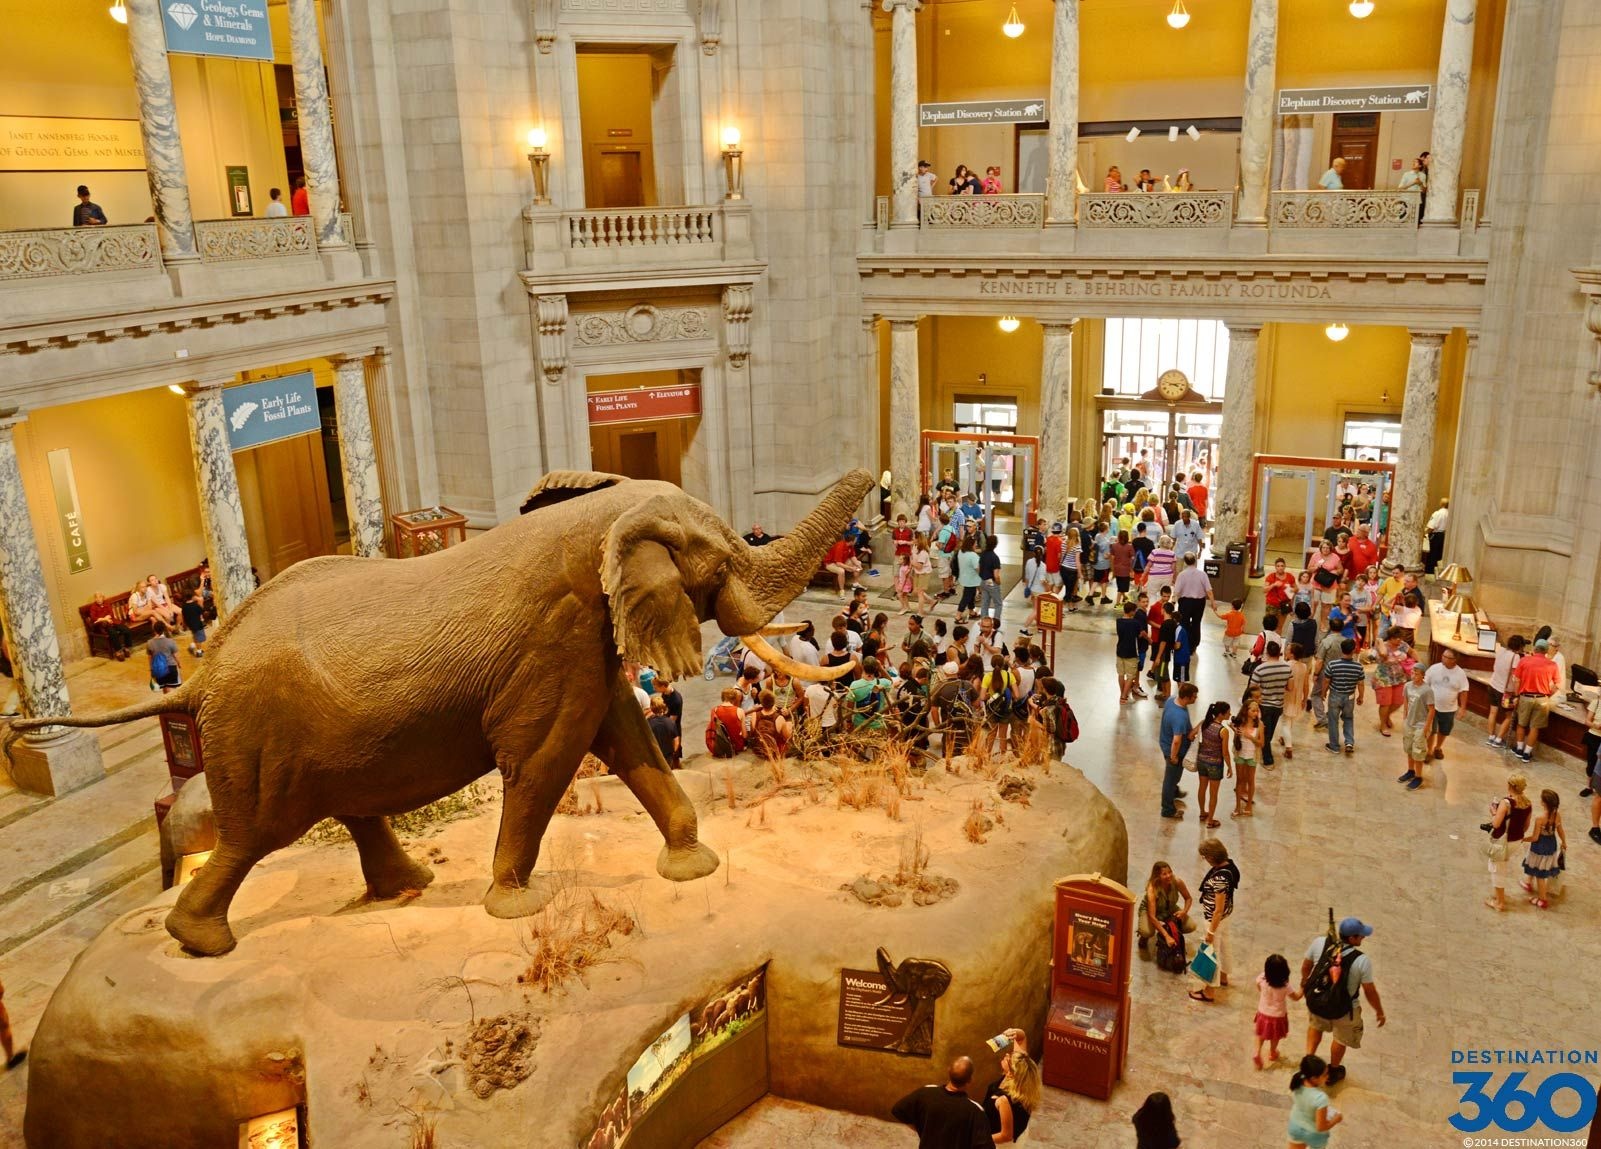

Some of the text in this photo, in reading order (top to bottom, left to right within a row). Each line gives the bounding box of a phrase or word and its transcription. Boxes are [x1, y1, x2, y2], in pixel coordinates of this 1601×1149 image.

[201, 0, 264, 18] Geology, Gems
[203, 14, 252, 31] & Minerals
[205, 32, 256, 45] HOPE DIAMOND
[1280, 94, 1402, 109] Elephant Discovery Station
[922, 108, 1021, 122] Elephant Discovery Station
[115, 147, 144, 157] MINER
[979, 282, 1331, 299] KENNETH E. BEHRING FAMILY ROTUNDA
[262, 391, 301, 410] Early Life
[656, 390, 683, 398] ELEVATOR
[263, 404, 312, 422] Fossil Plants
[615, 402, 638, 410] PLANTS
[65, 511, 82, 547] CAFÉ
[845, 977, 887, 991] Welcome
[1048, 1031, 1108, 1055] DONATIONS
